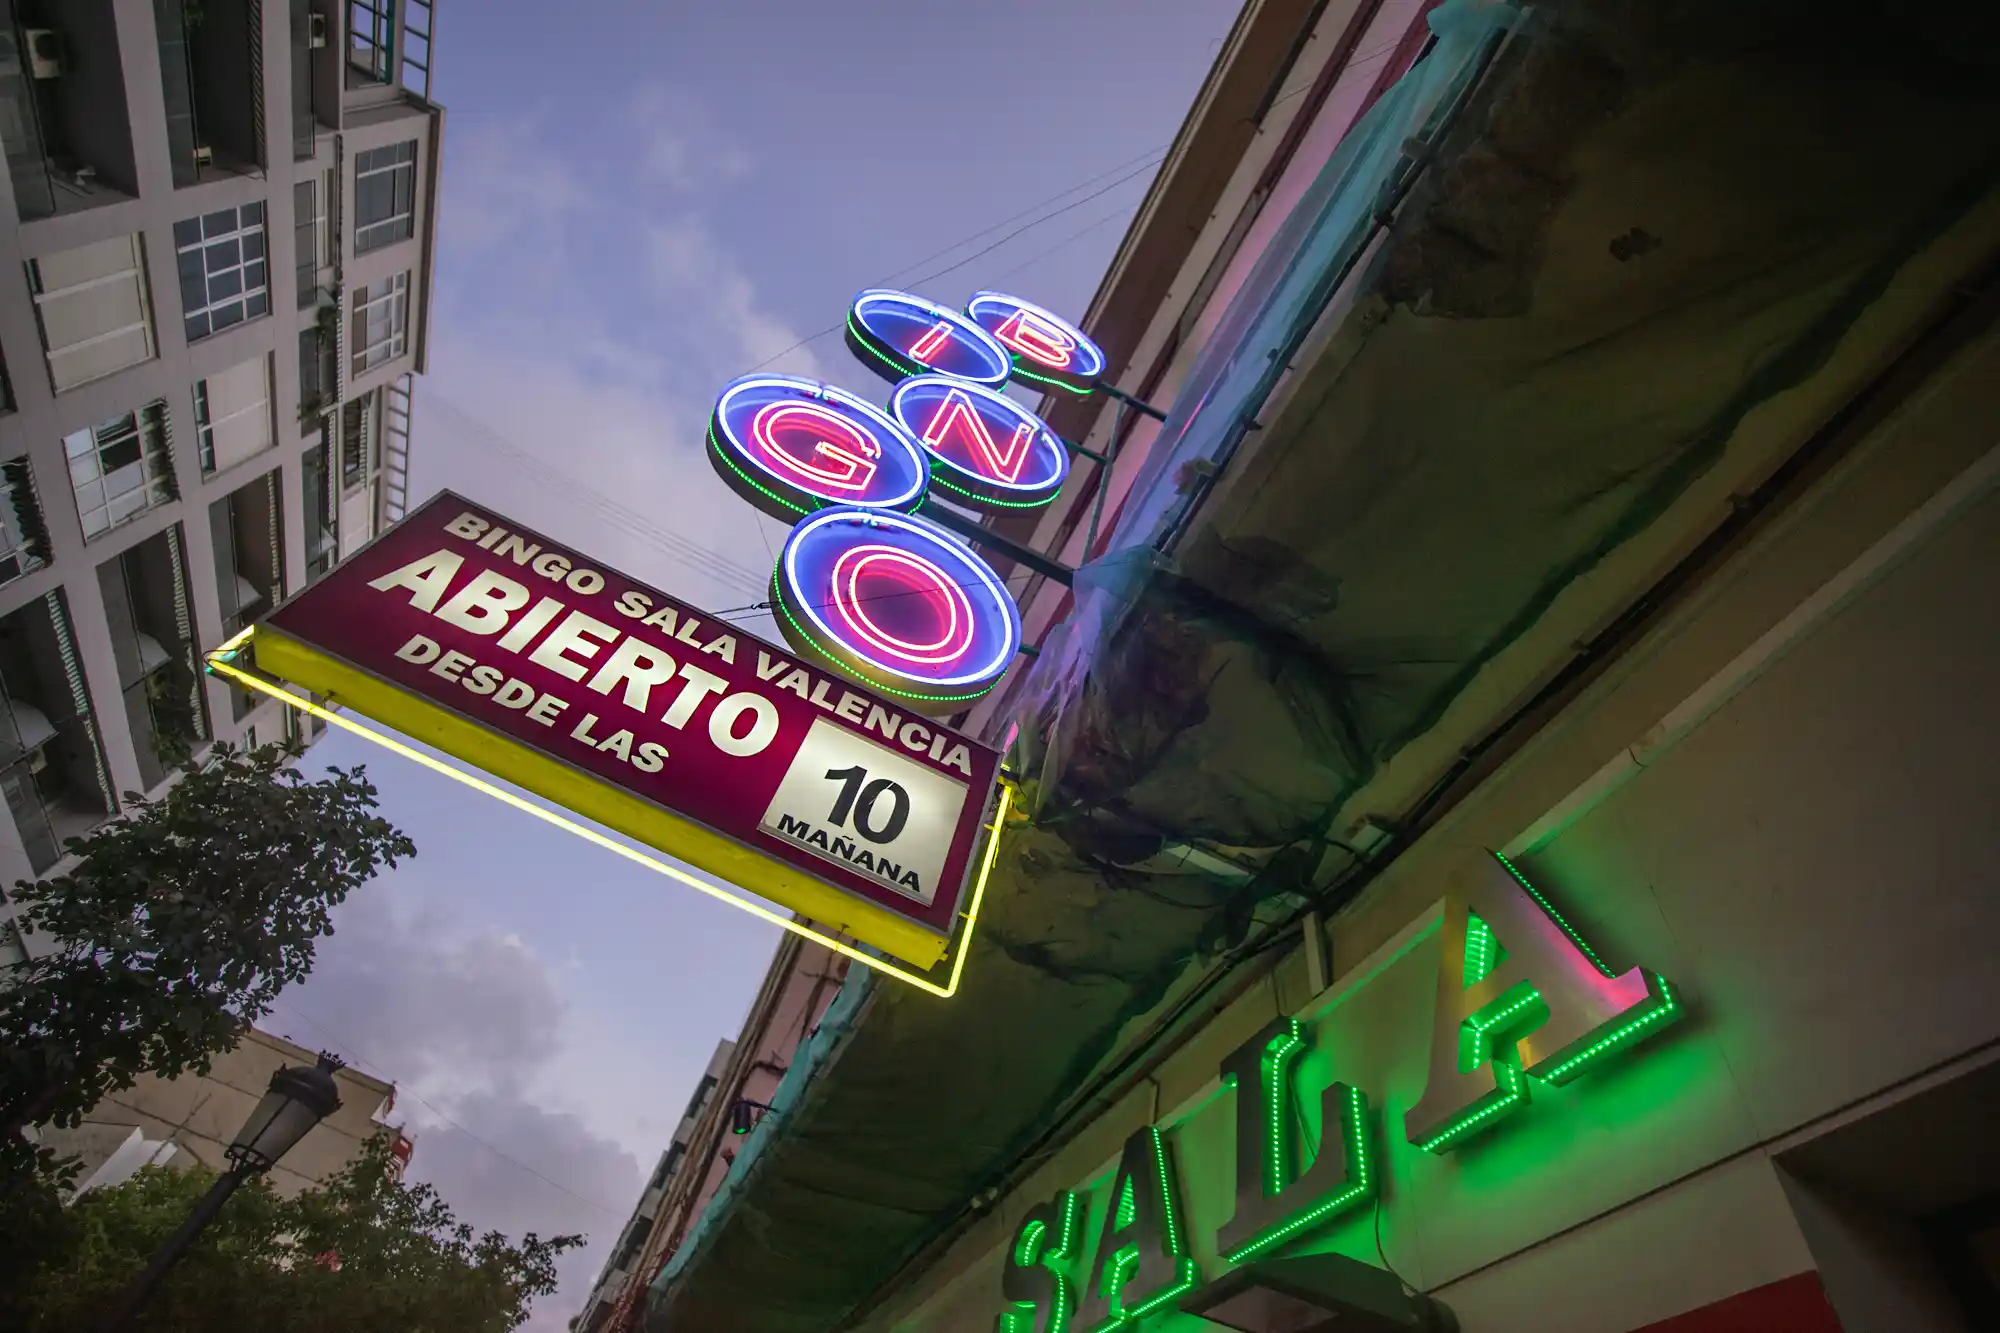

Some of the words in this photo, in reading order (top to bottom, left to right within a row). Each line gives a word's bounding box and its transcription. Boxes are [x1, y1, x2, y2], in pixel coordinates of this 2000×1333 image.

[753, 308, 1077, 664] BINGO
[367, 548, 780, 757] ABIERTO
[395, 634, 569, 727] DESDE
[571, 712, 669, 773] LAS
[443, 511, 605, 596] BINGO
[613, 589, 738, 664] SALA
[755, 651, 973, 776] VALENCIA
[777, 813, 921, 892] MAÑANA
[823, 764, 910, 845] 10
[995, 847, 1682, 1333] SALA
